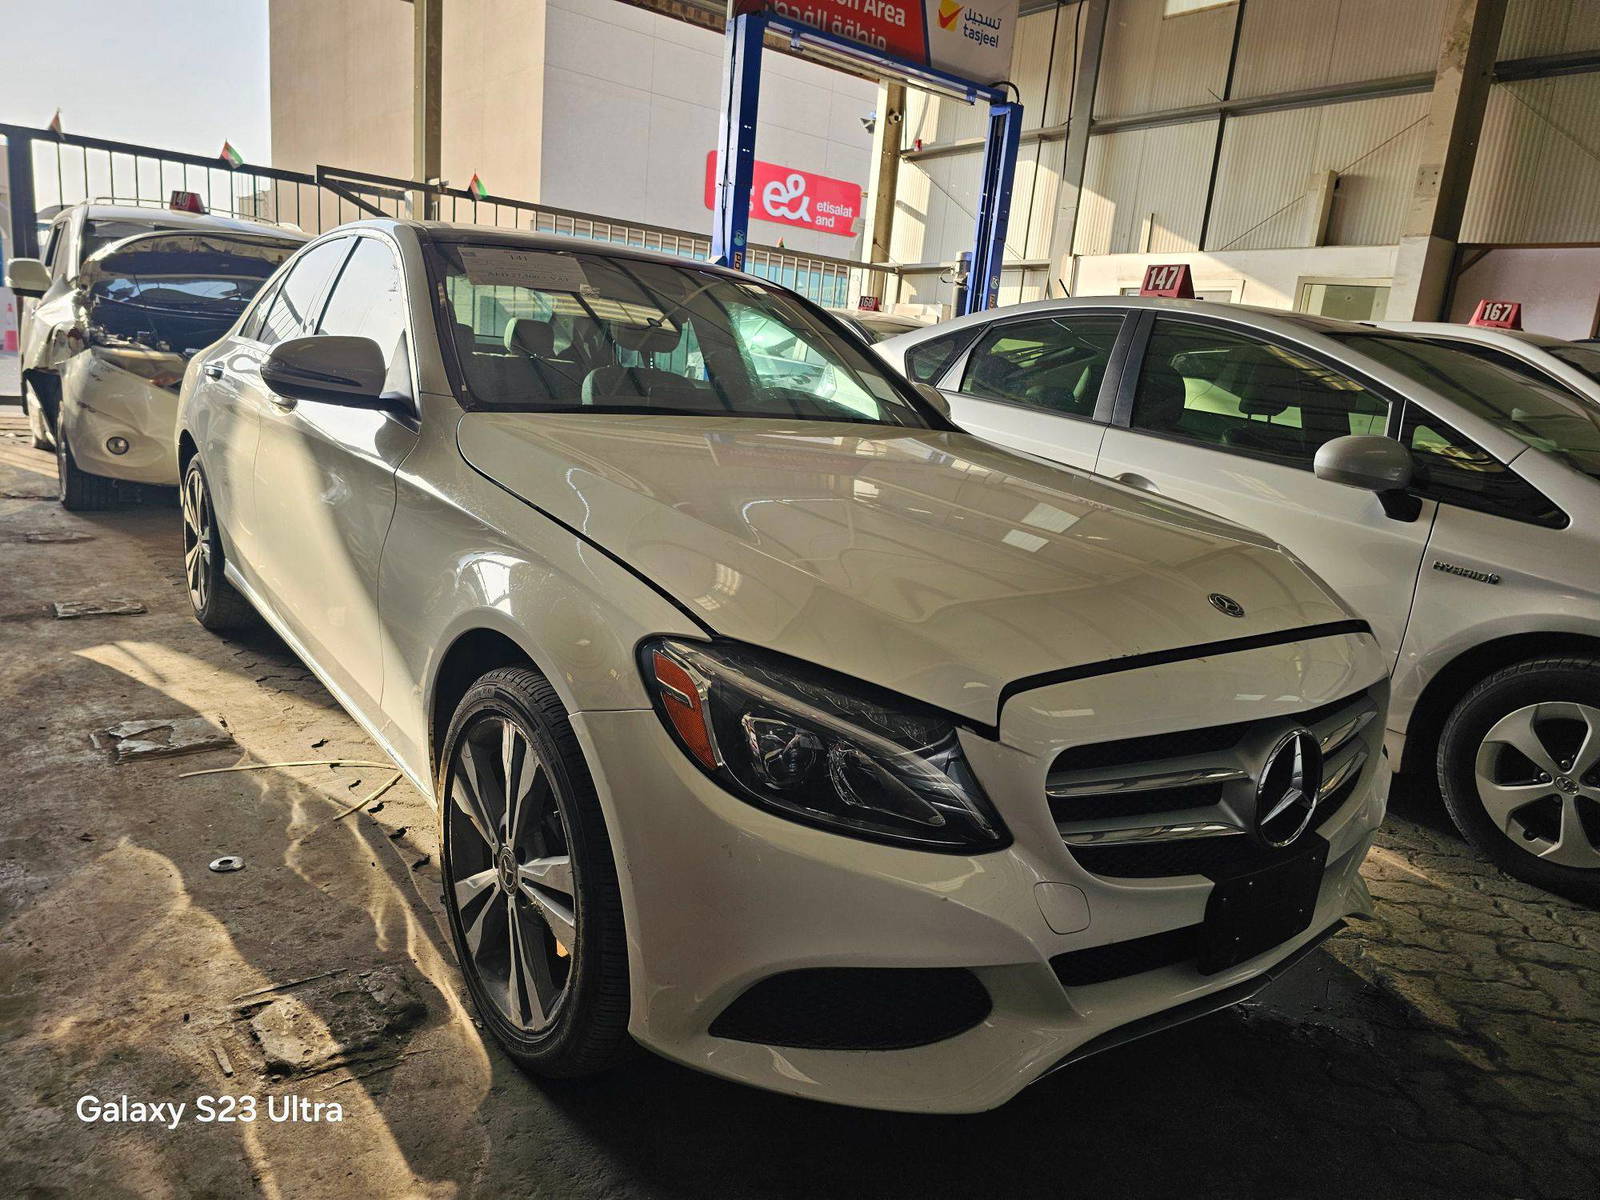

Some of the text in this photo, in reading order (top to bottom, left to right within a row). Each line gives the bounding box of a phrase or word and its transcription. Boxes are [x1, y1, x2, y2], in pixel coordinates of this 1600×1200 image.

[864, 0, 906, 27] Area
[964, 8, 1002, 30] تسجيل
[963, 23, 999, 48] tasjeel
[816, 201, 853, 218] etisalat
[815, 216, 835, 228] and
[1147, 266, 1180, 290] 147
[1483, 302, 1513, 321] 167
